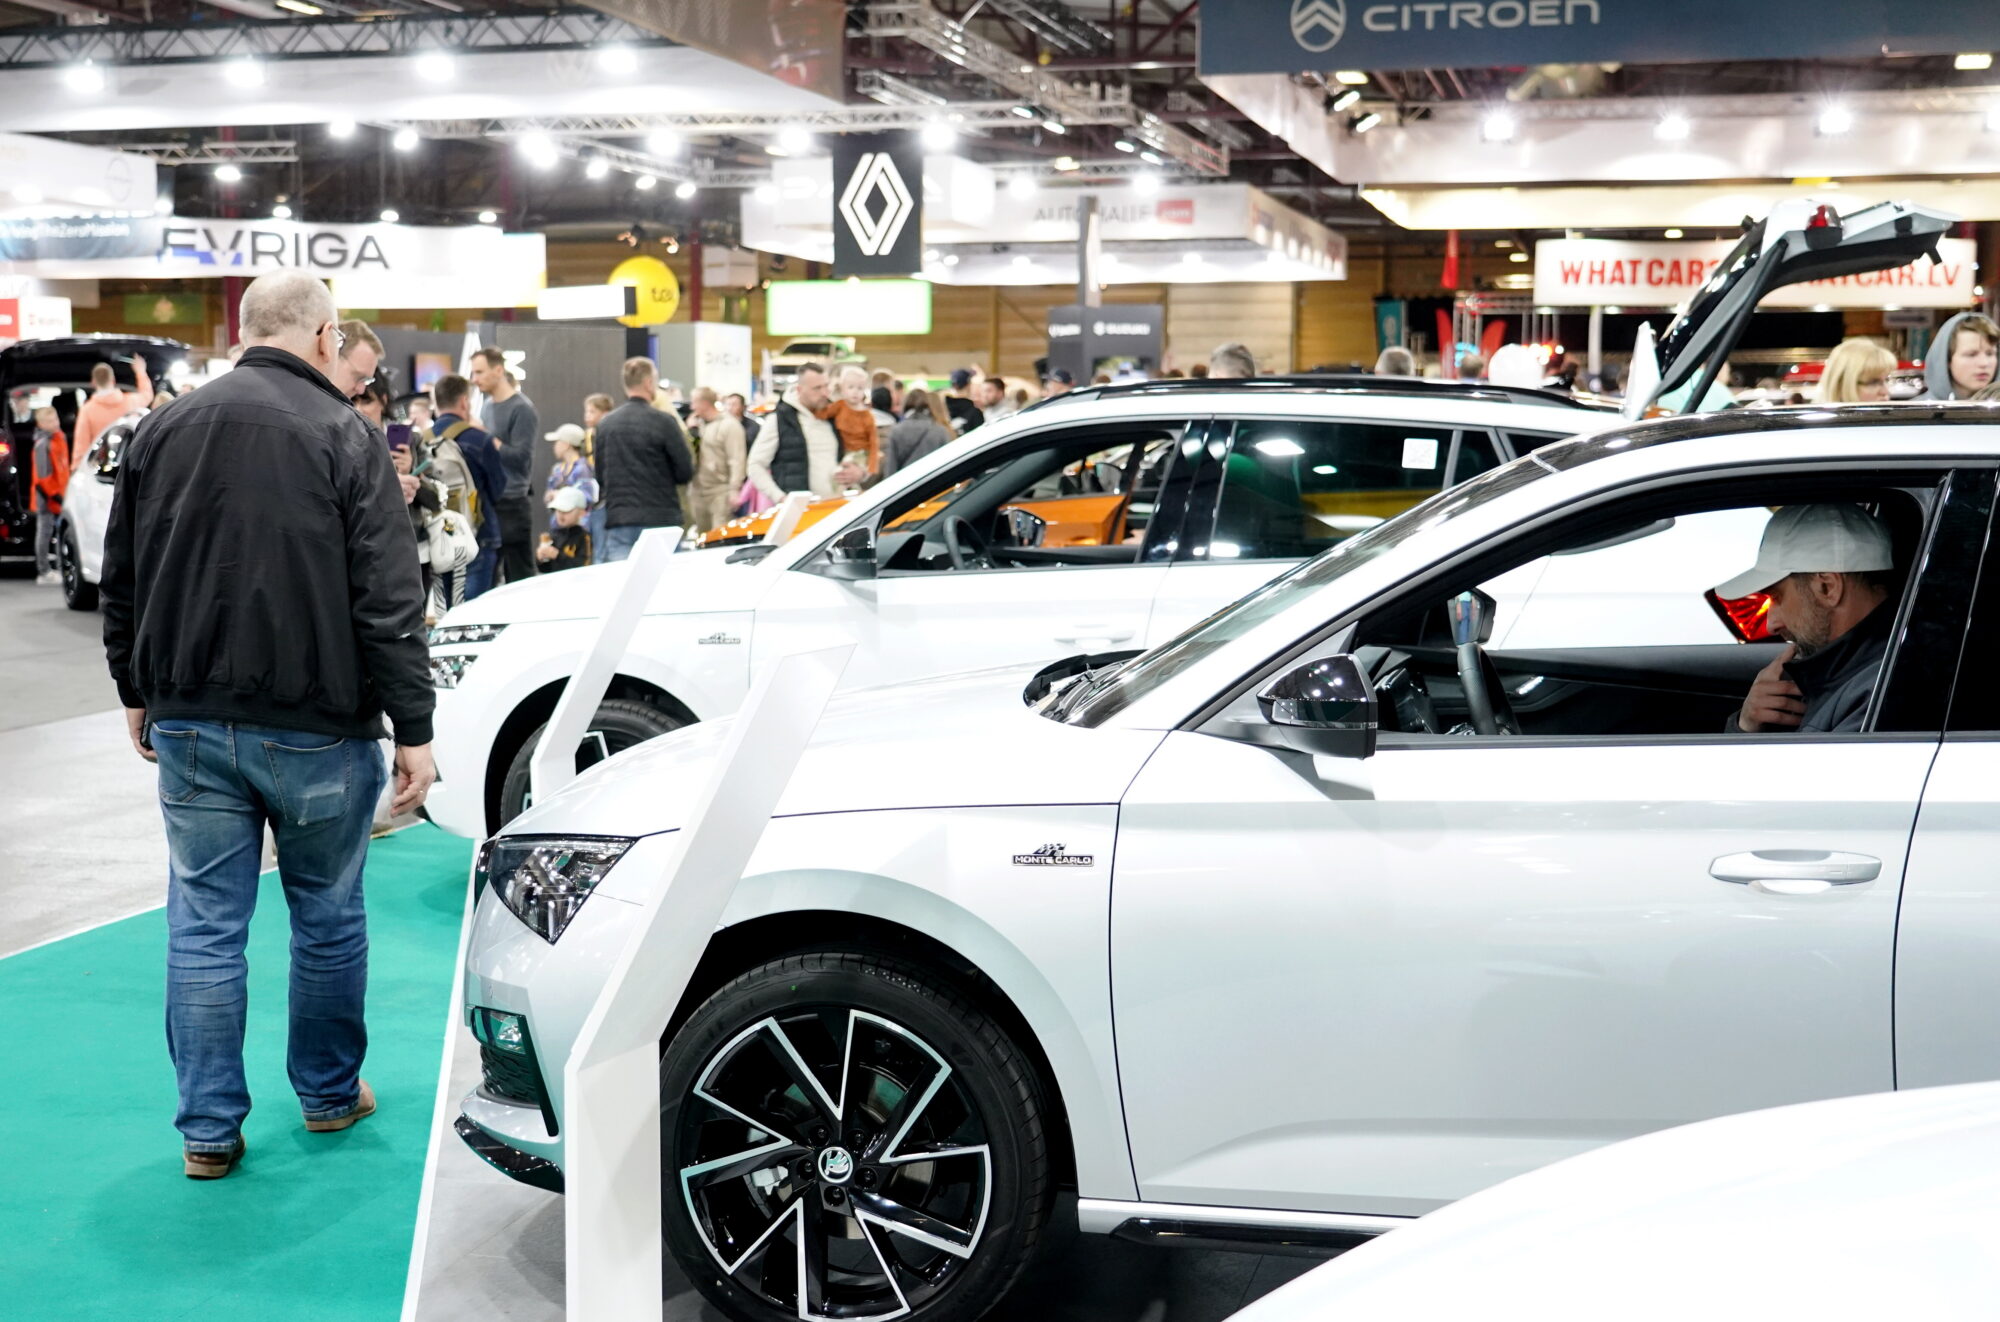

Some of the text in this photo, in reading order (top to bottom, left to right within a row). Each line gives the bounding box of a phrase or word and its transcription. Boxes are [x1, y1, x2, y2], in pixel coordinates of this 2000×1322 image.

[1796, 264, 1960, 288] TCAR.LV
[1014, 856, 1091, 865] MONTE CARLO
